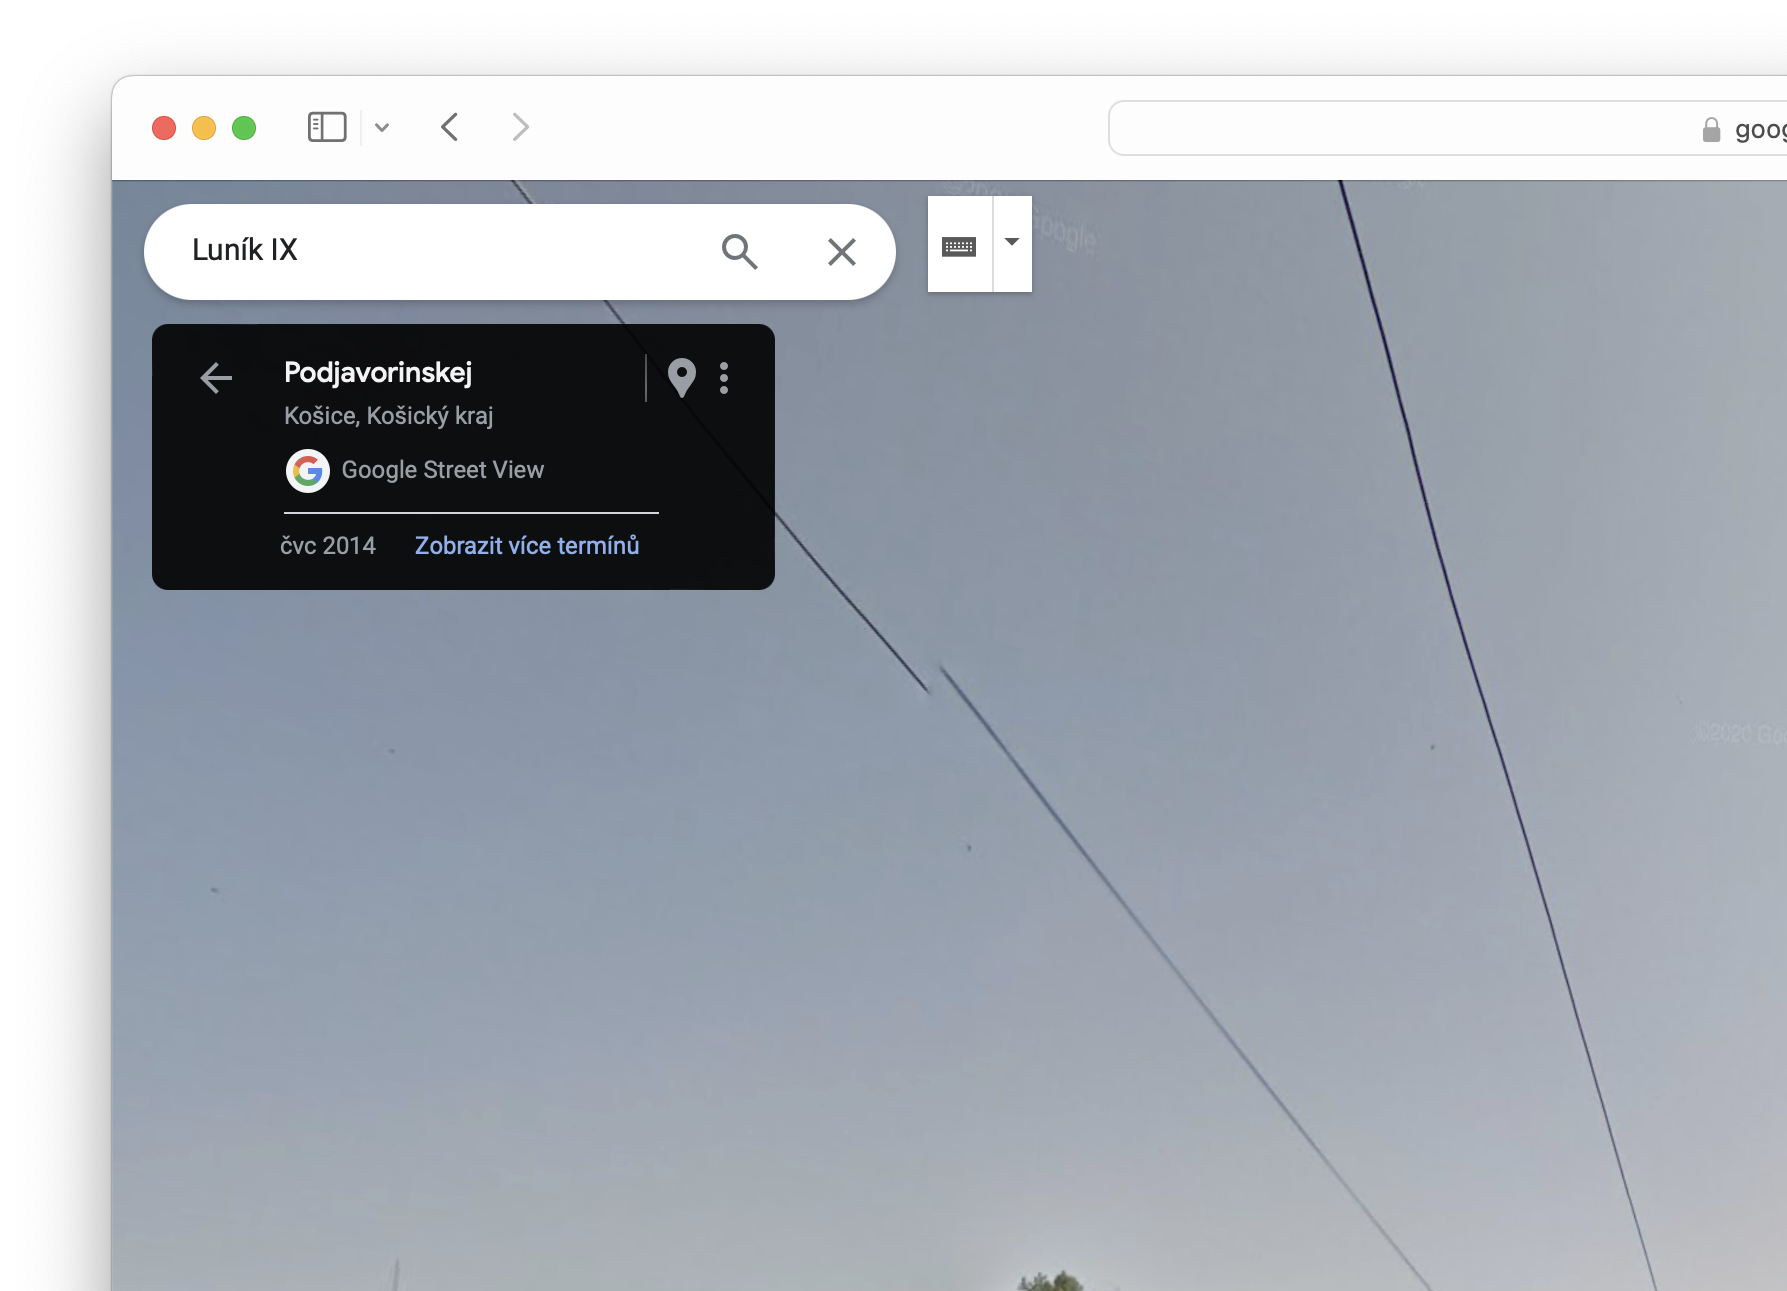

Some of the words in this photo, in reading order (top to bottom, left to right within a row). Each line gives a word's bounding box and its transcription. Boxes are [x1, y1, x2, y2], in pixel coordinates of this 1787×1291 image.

[193, 236, 264, 262] Luník
[272, 237, 298, 261] IX
[285, 360, 472, 390] Podjavorinskej
[285, 404, 361, 428] Košice,
[367, 404, 450, 430] Košický
[455, 404, 493, 430] kraj
[342, 458, 418, 484] Google
[423, 459, 487, 479] Street
[492, 459, 545, 479] View
[280, 534, 317, 555] čvc
[322, 535, 377, 555] 2014
[414, 534, 504, 556] Zobrazit
[507, 534, 552, 556] více
[556, 533, 640, 556] termínů
